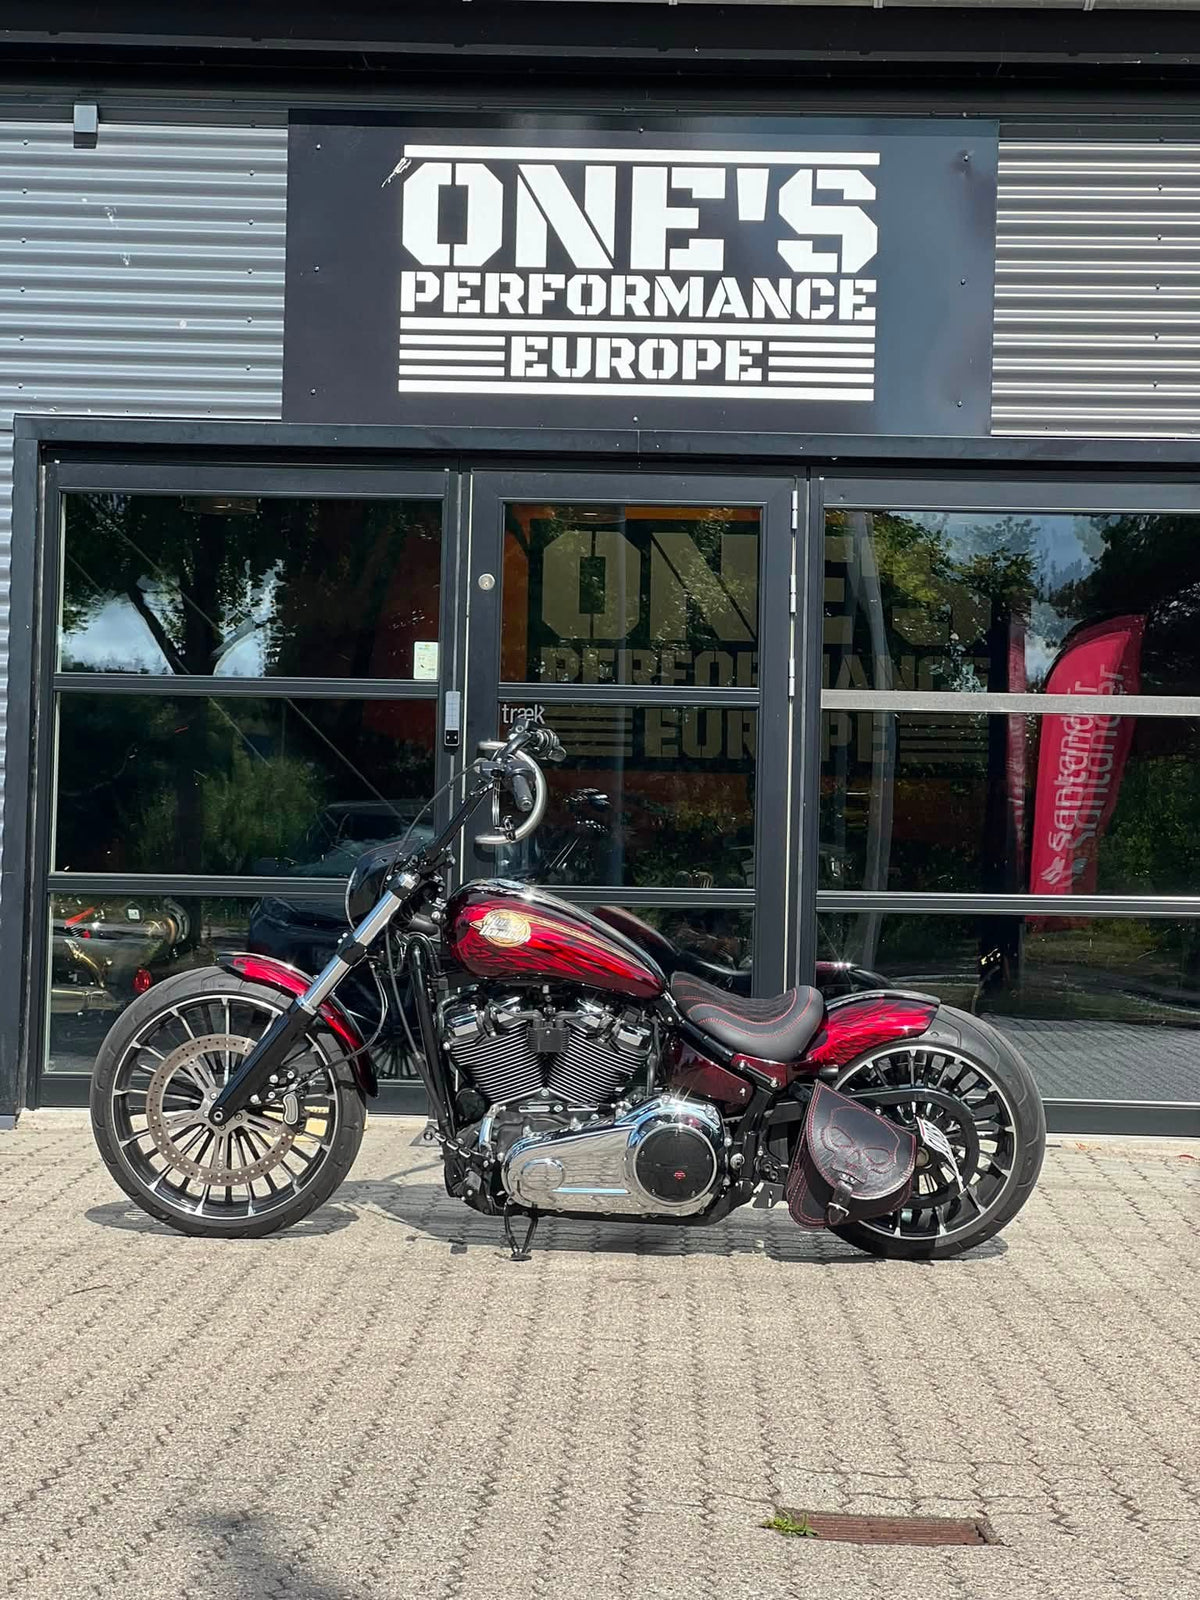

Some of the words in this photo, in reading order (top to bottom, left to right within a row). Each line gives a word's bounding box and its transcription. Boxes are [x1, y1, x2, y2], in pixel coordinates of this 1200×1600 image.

[402, 162, 878, 273] ONE'S
[401, 272, 877, 321] PERFORMANCE
[509, 336, 763, 382] EUROPE
[501, 703, 545, 724] træk
